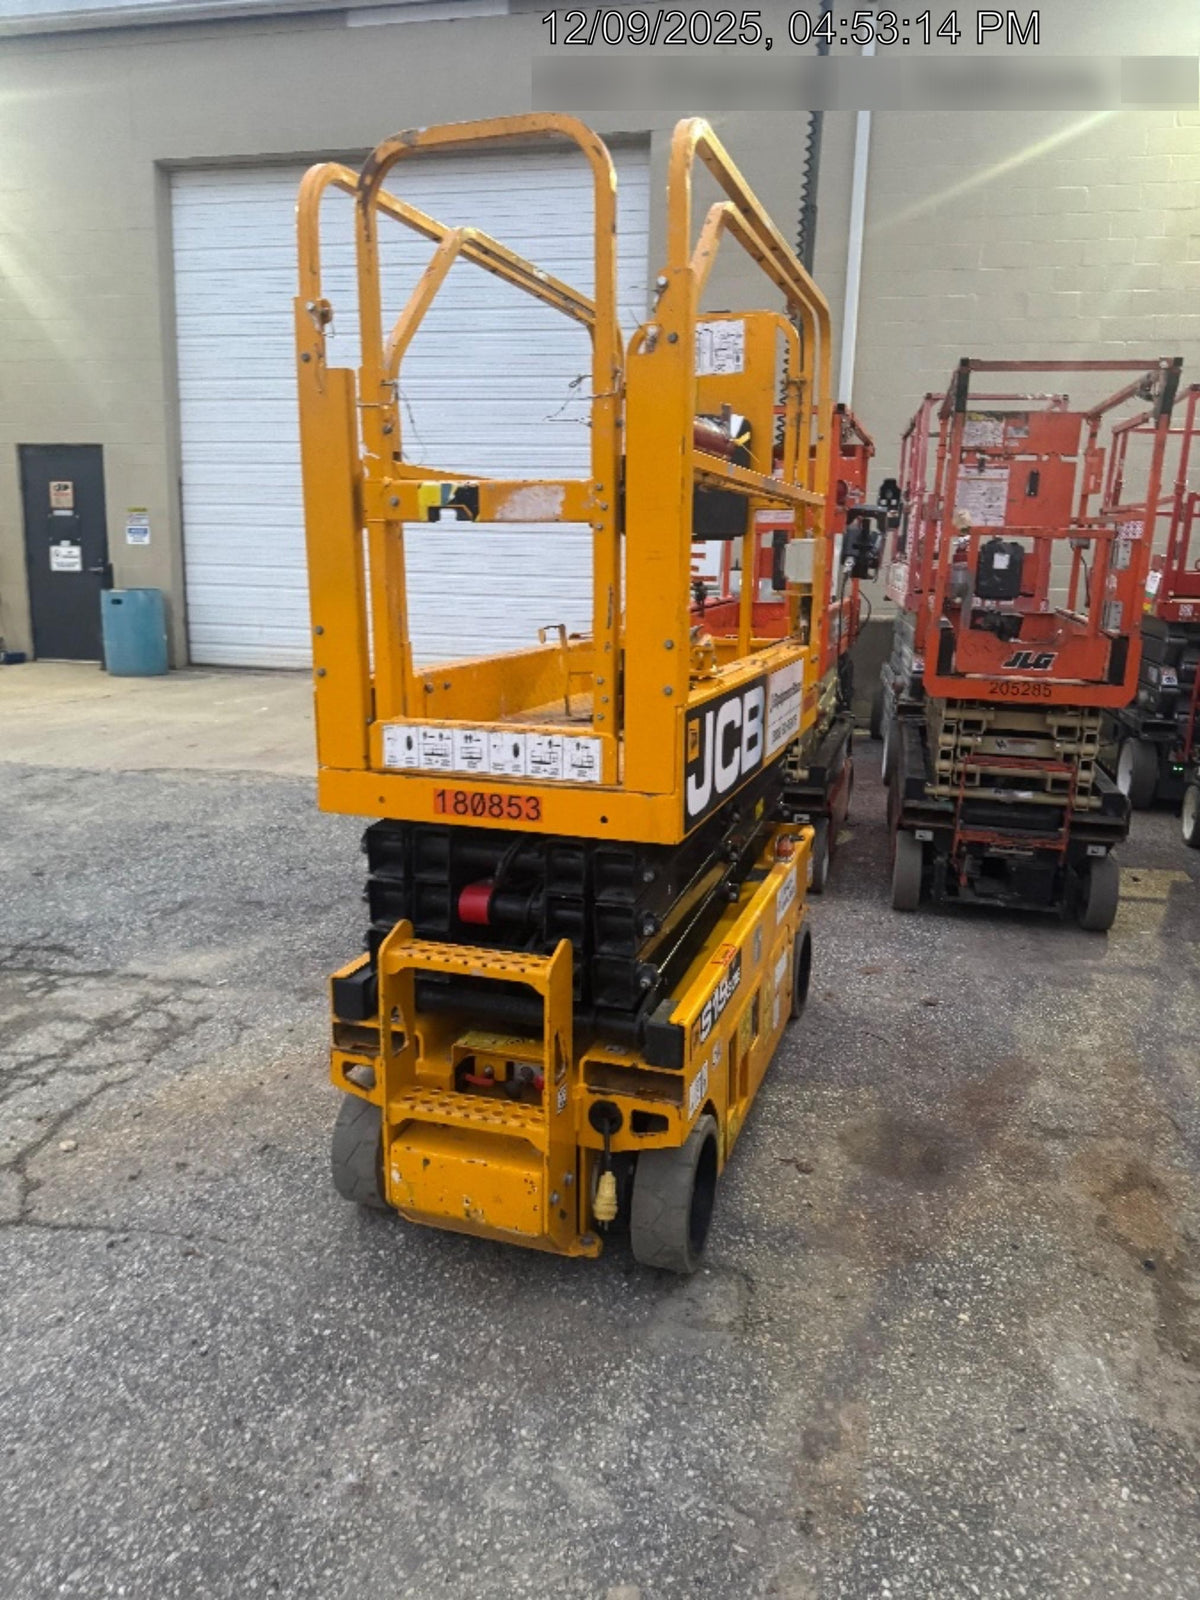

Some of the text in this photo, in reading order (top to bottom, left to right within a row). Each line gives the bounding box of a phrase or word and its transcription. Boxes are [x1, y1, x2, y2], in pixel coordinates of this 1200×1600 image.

[1001, 650, 1059, 671] JLG
[988, 682, 1052, 698] 205285
[687, 685, 765, 817] JCB
[436, 790, 542, 821] 180853
